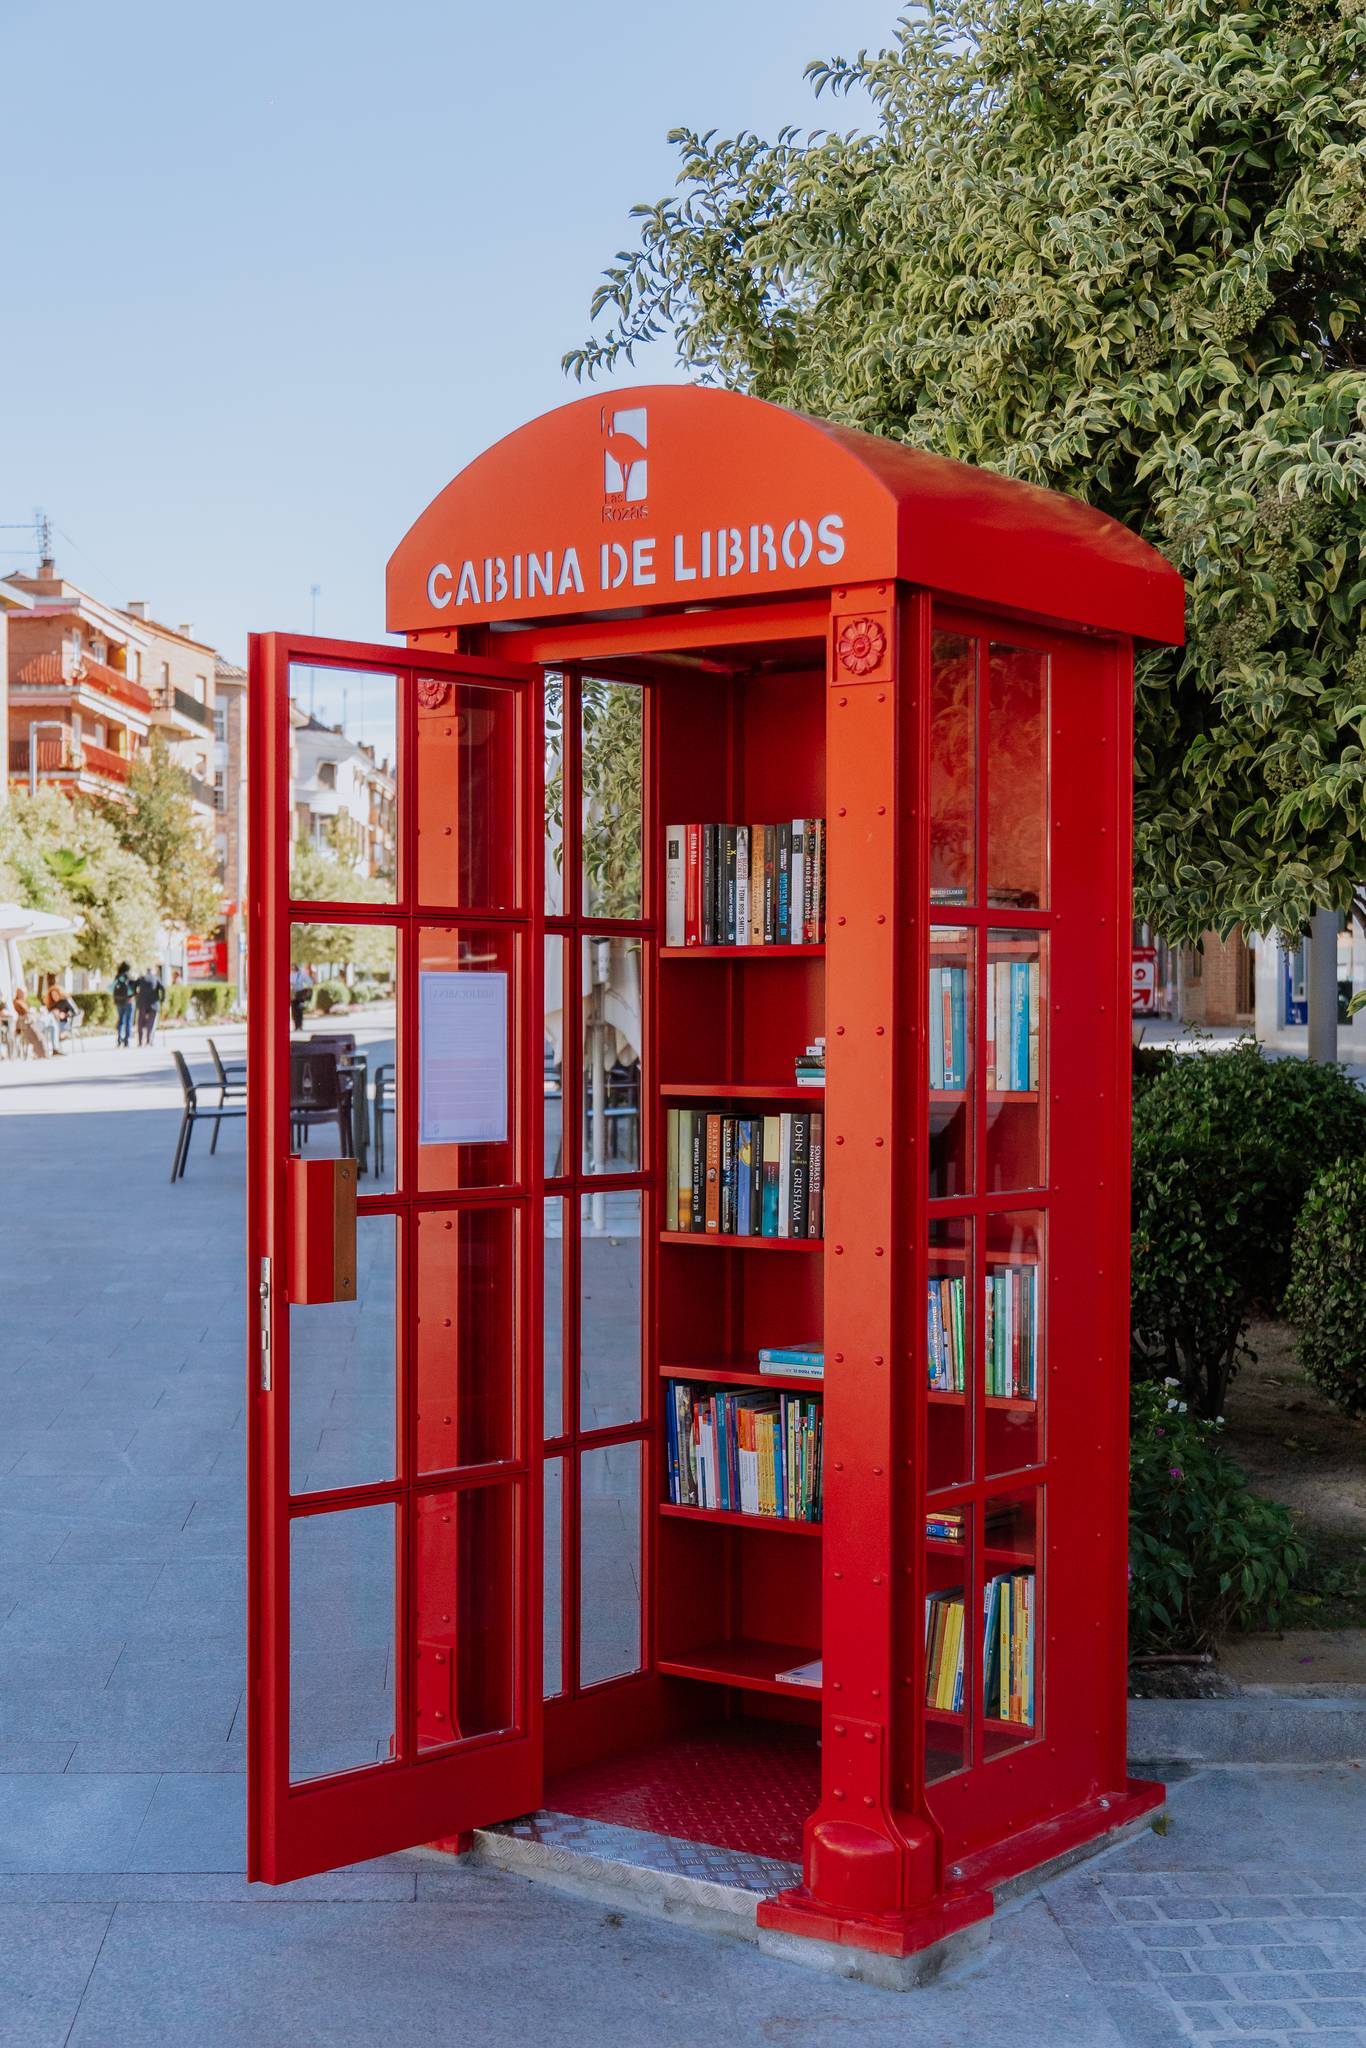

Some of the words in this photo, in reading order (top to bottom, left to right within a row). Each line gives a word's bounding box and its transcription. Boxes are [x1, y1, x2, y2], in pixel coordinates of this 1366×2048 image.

[601, 505, 648, 523] Rozas
[604, 493, 624, 505] Las
[426, 546, 584, 609] CABINA
[600, 538, 656, 590] DE
[674, 514, 845, 582] LIBROS
[779, 873, 787, 904] VERDON
[779, 905, 787, 924] JOHN
[793, 1120, 803, 1152] JOHN
[813, 1145, 821, 1180] SOMBRAS
[793, 1168, 803, 1221] GRISHAM
[813, 1182, 821, 1193] DE
